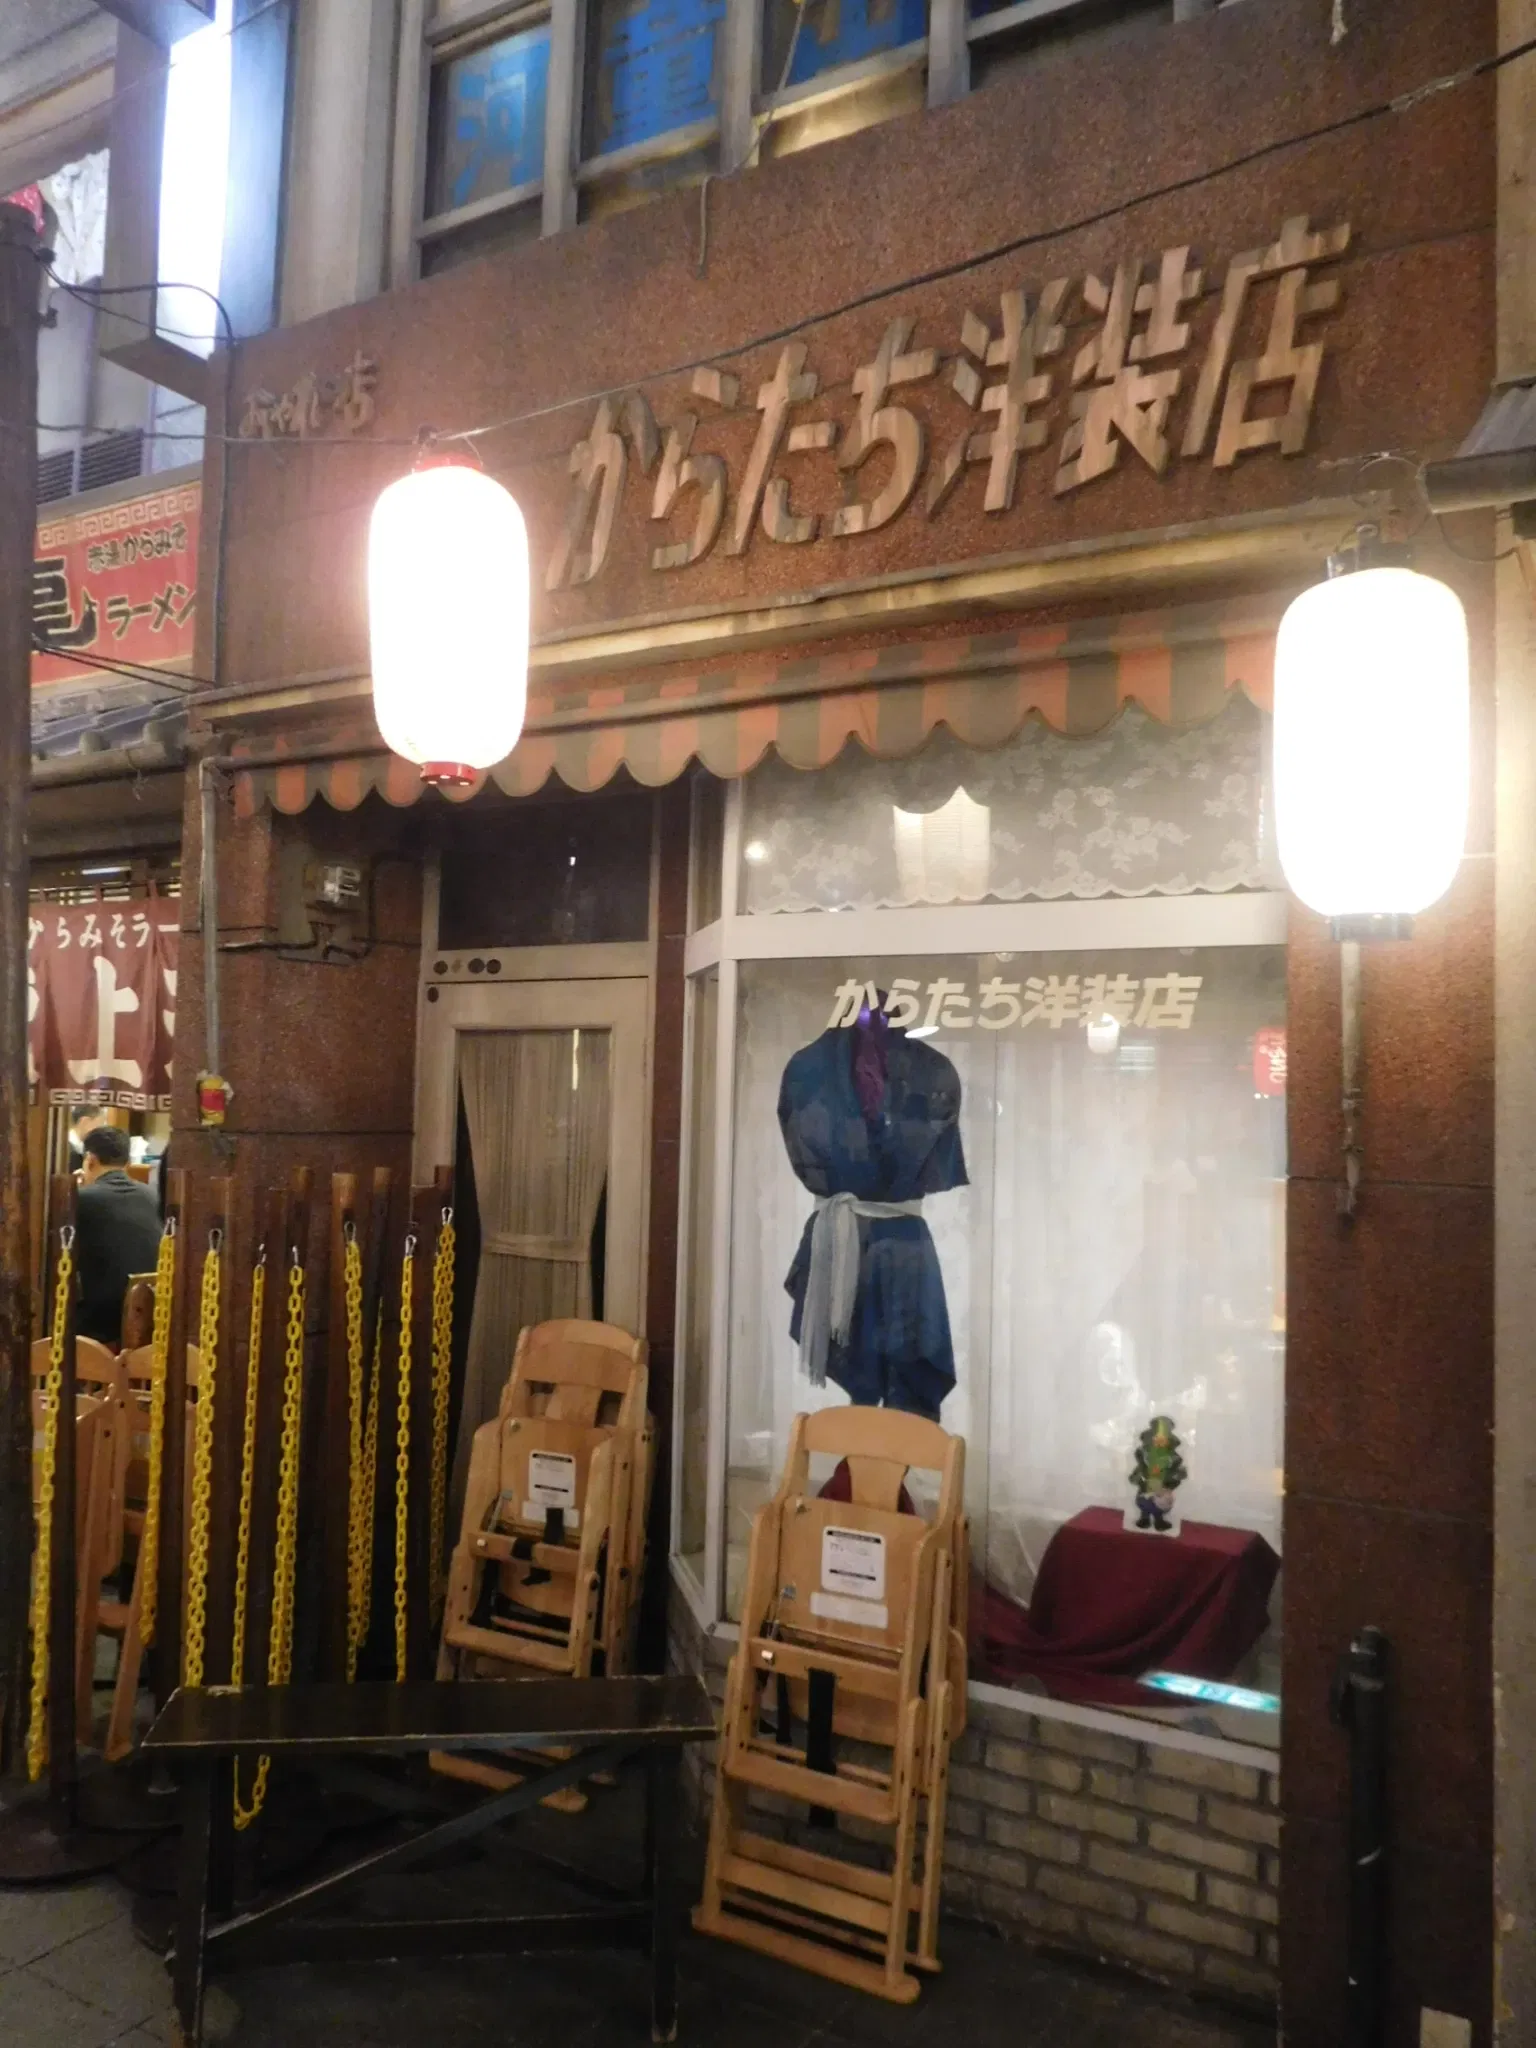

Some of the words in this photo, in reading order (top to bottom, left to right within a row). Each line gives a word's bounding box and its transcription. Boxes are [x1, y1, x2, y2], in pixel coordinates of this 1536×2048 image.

[546, 214, 1352, 592] からたち洋装店
[105, 582, 197, 640] ラーメン
[826, 972, 1203, 1030] からたち洋装店
